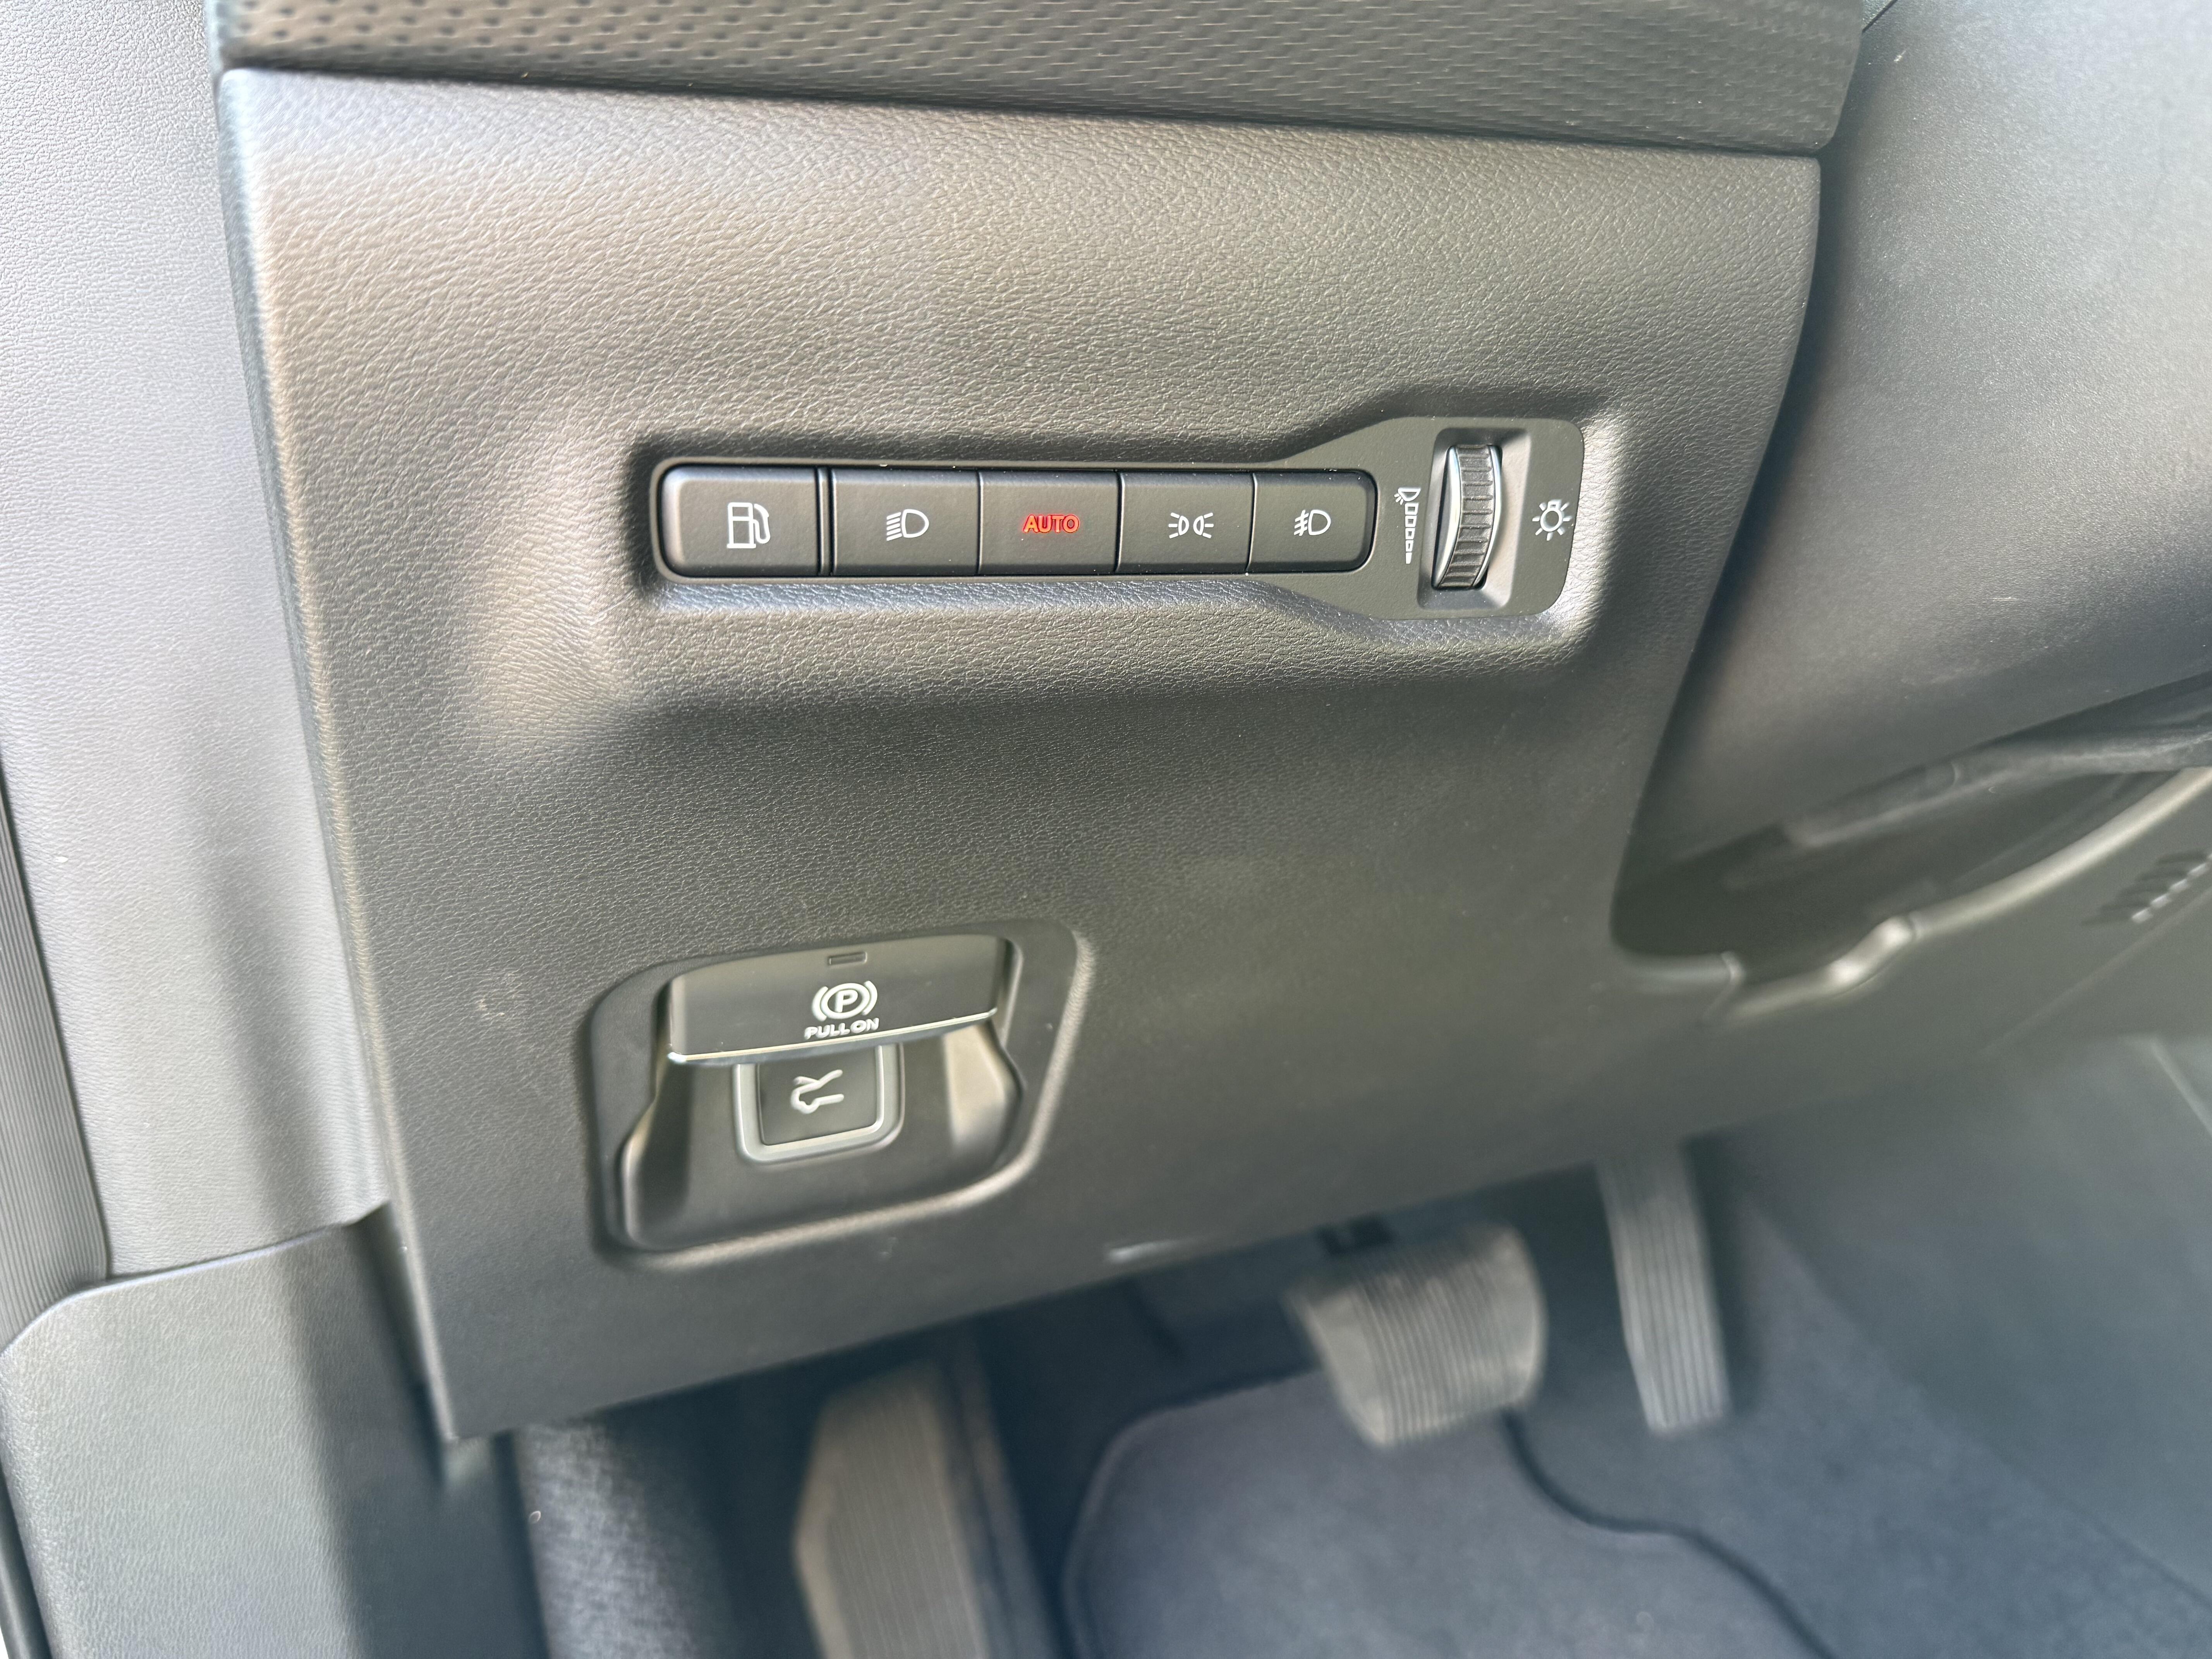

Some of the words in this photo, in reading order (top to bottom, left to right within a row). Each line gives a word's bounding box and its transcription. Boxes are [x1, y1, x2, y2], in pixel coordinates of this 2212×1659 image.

[1023, 514, 1079, 533] AUTO
[804, 1023, 850, 1040] PULL
[850, 1018, 879, 1033] ON
